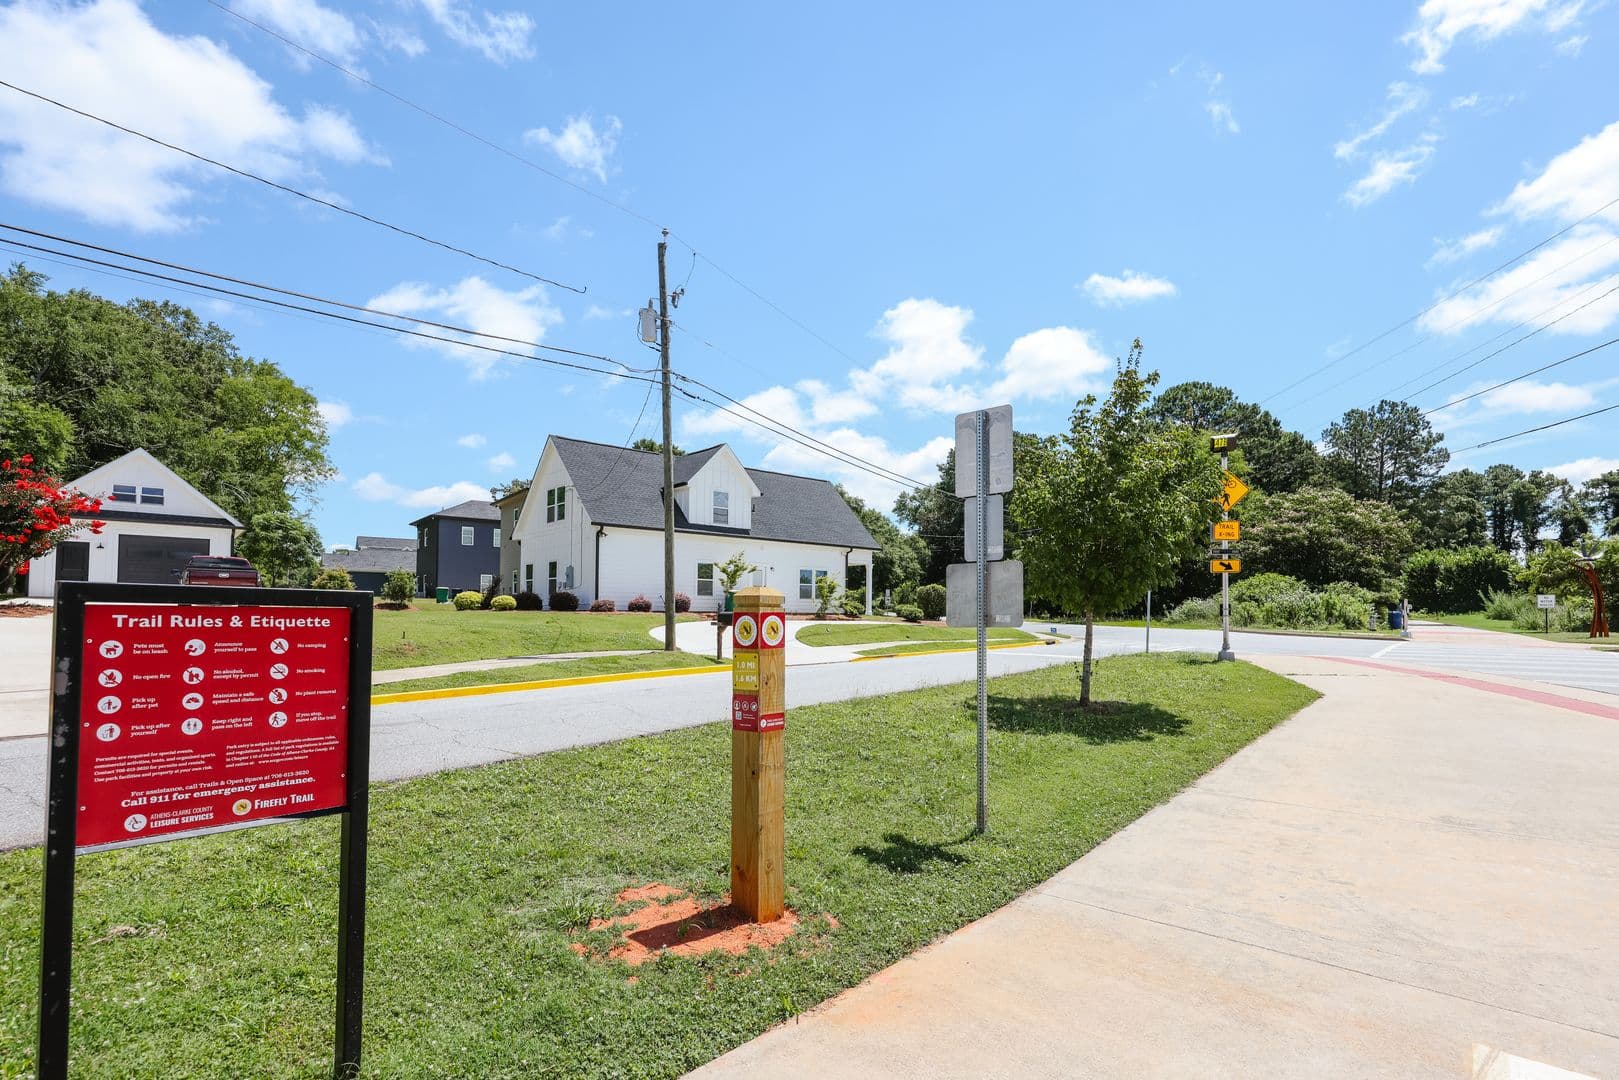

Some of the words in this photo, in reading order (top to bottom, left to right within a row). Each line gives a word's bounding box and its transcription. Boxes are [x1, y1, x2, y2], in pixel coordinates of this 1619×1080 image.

[112, 614, 162, 628] Trail
[170, 614, 223, 628] Rules
[229, 615, 243, 628] &
[250, 615, 331, 630] Etiquette
[746, 674, 757, 682] KM
[130, 730, 158, 738] yourself
[121, 796, 148, 808] Call
[150, 795, 170, 804] 911
[172, 792, 192, 801] for
[193, 784, 257, 798] emergency
[258, 777, 316, 790] assistance.
[146, 785, 185, 795] assistance,
[199, 780, 220, 788] Trails
[227, 776, 244, 786] Open
[245, 774, 264, 784] Space
[150, 808, 191, 820] ATHENS-CLARKE
[192, 806, 214, 814] COUNTY
[150, 818, 180, 828] LEISURE
[180, 812, 214, 824] SERVICES
